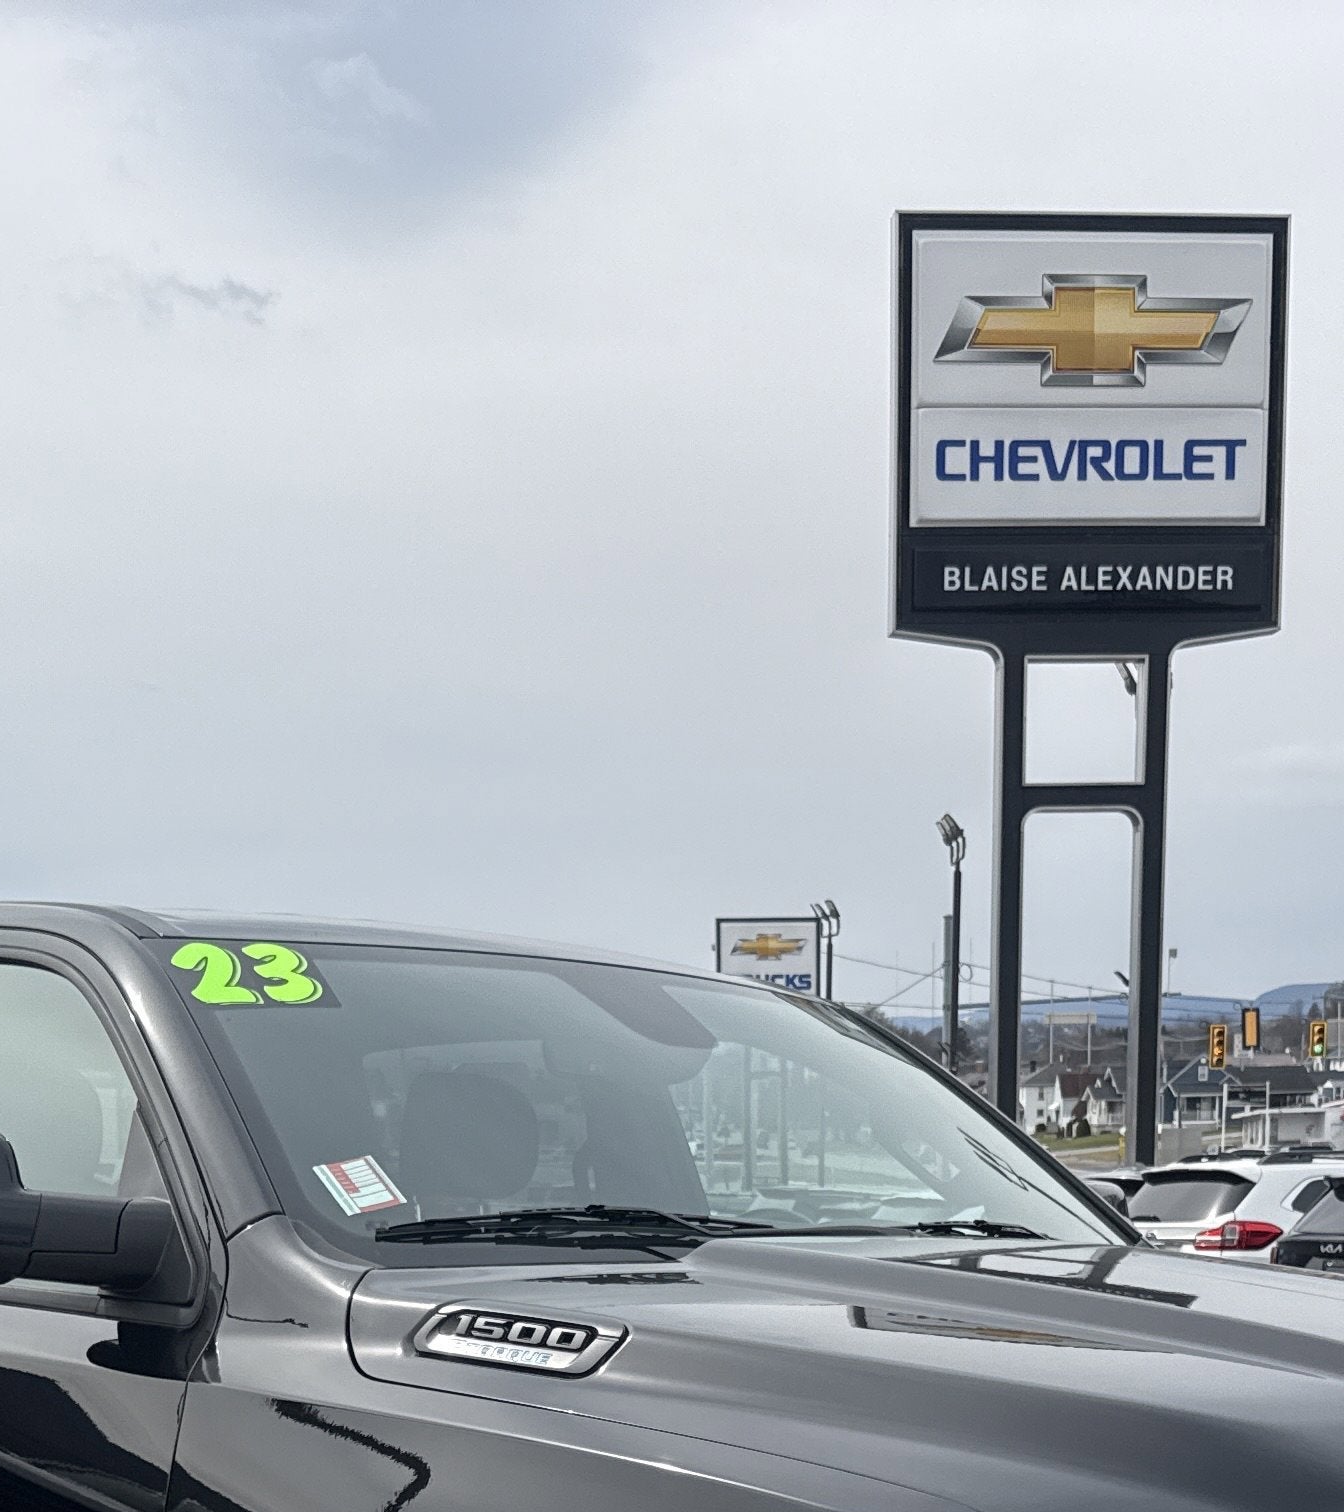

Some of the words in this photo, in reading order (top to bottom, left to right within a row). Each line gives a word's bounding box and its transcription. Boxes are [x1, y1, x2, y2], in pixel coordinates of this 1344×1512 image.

[935, 438, 1247, 482] CHEVROLET
[943, 565, 1048, 592] BLAISE
[1060, 565, 1234, 592] ALEXANDER
[170, 942, 323, 1005] 23
[456, 1314, 589, 1350] 1500
